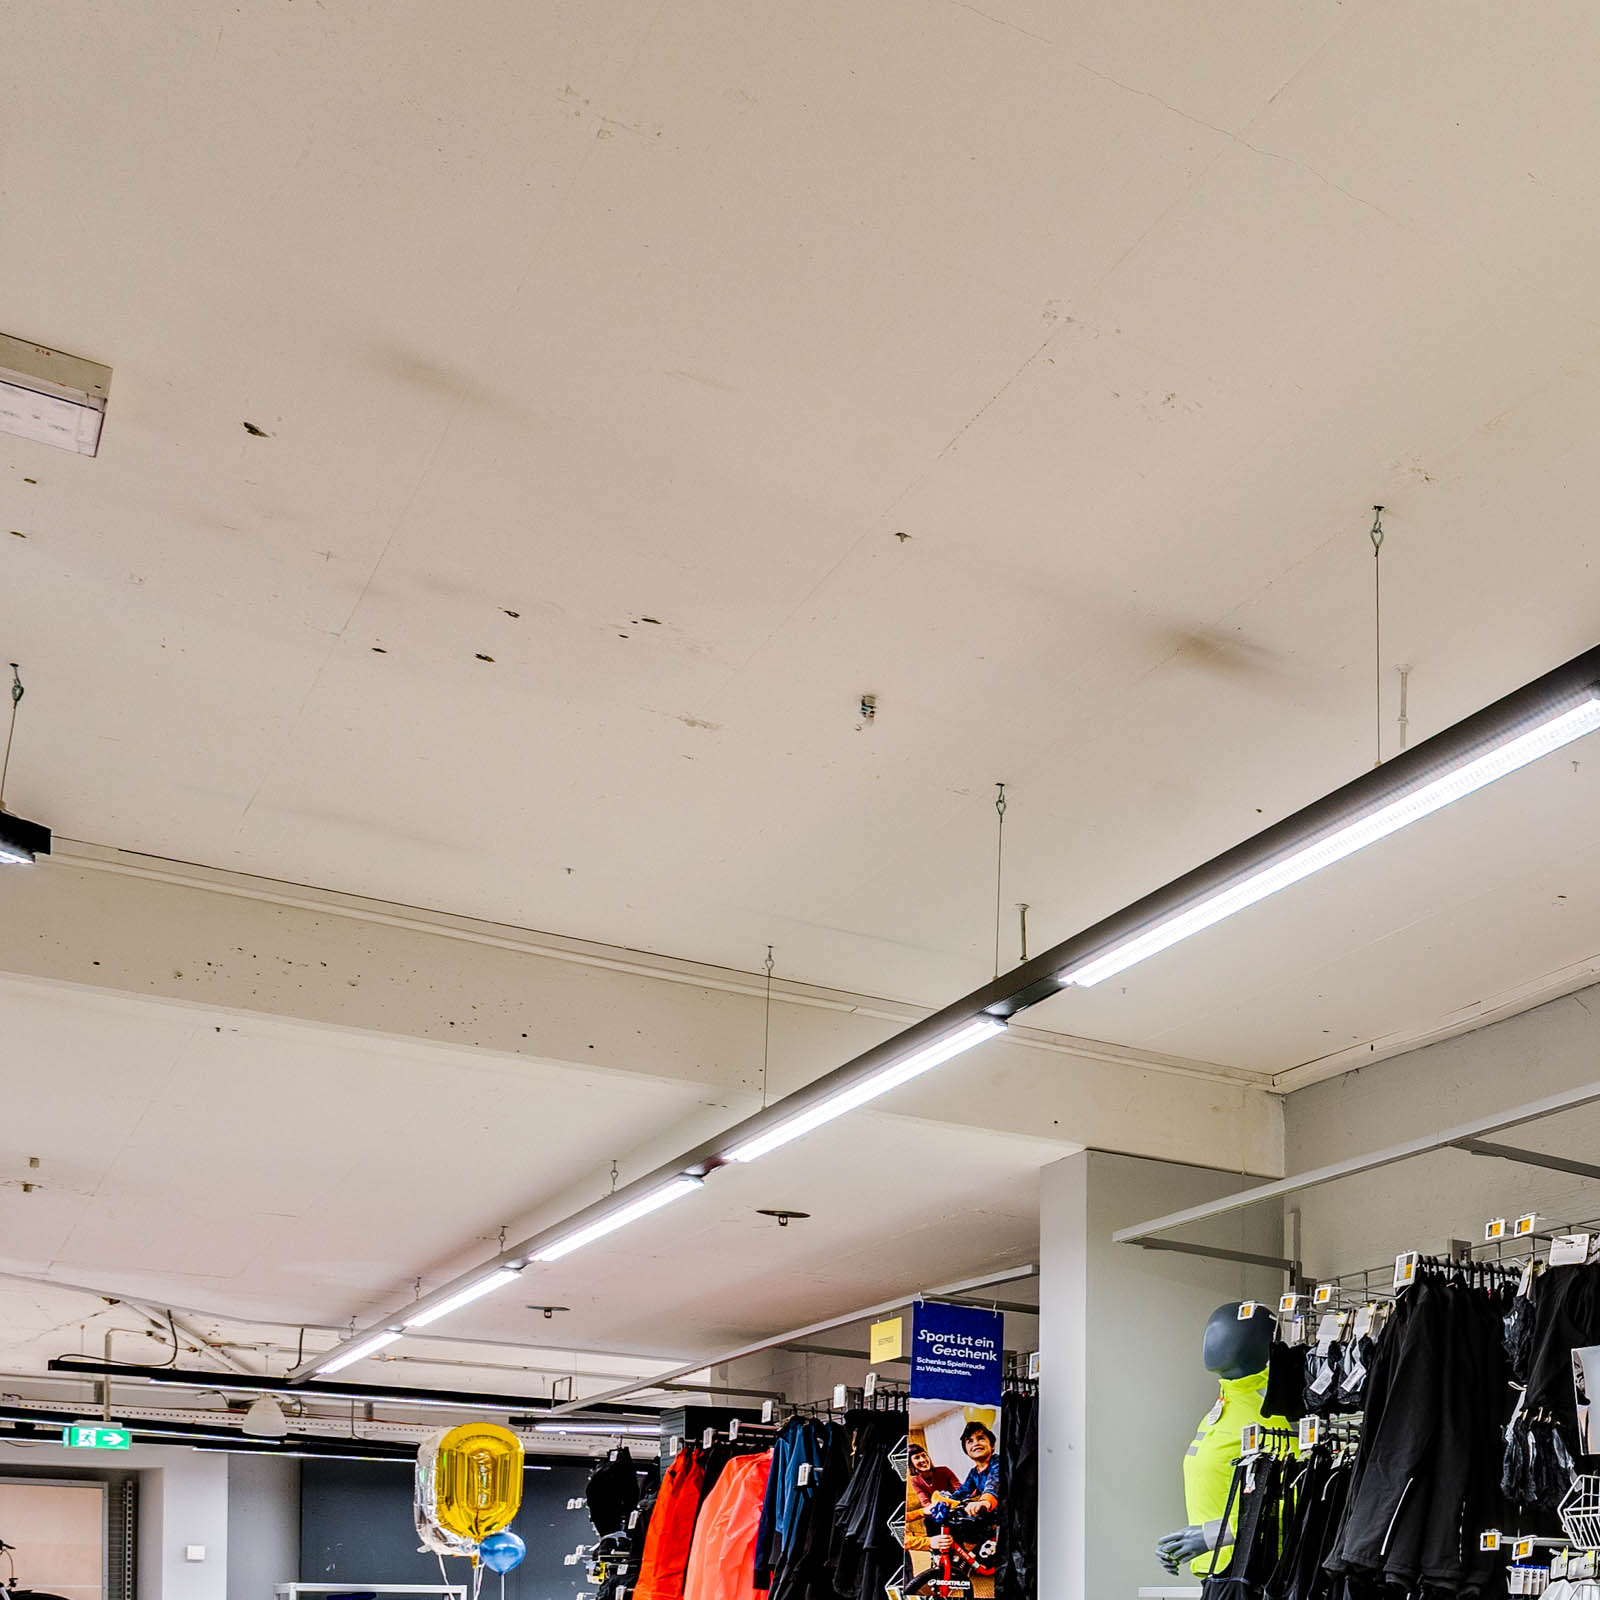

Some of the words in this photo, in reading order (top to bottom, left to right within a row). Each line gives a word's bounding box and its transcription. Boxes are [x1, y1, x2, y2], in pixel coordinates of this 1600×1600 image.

[917, 1329, 955, 1344] Sport
[957, 1334, 973, 1346] ist
[974, 1337, 994, 1349] ein
[932, 1343, 998, 1362] Geschenk
[916, 1356, 947, 1366] Schenke
[947, 1358, 986, 1370] Spielfreude
[925, 1365, 972, 1377] Weihnachten.
